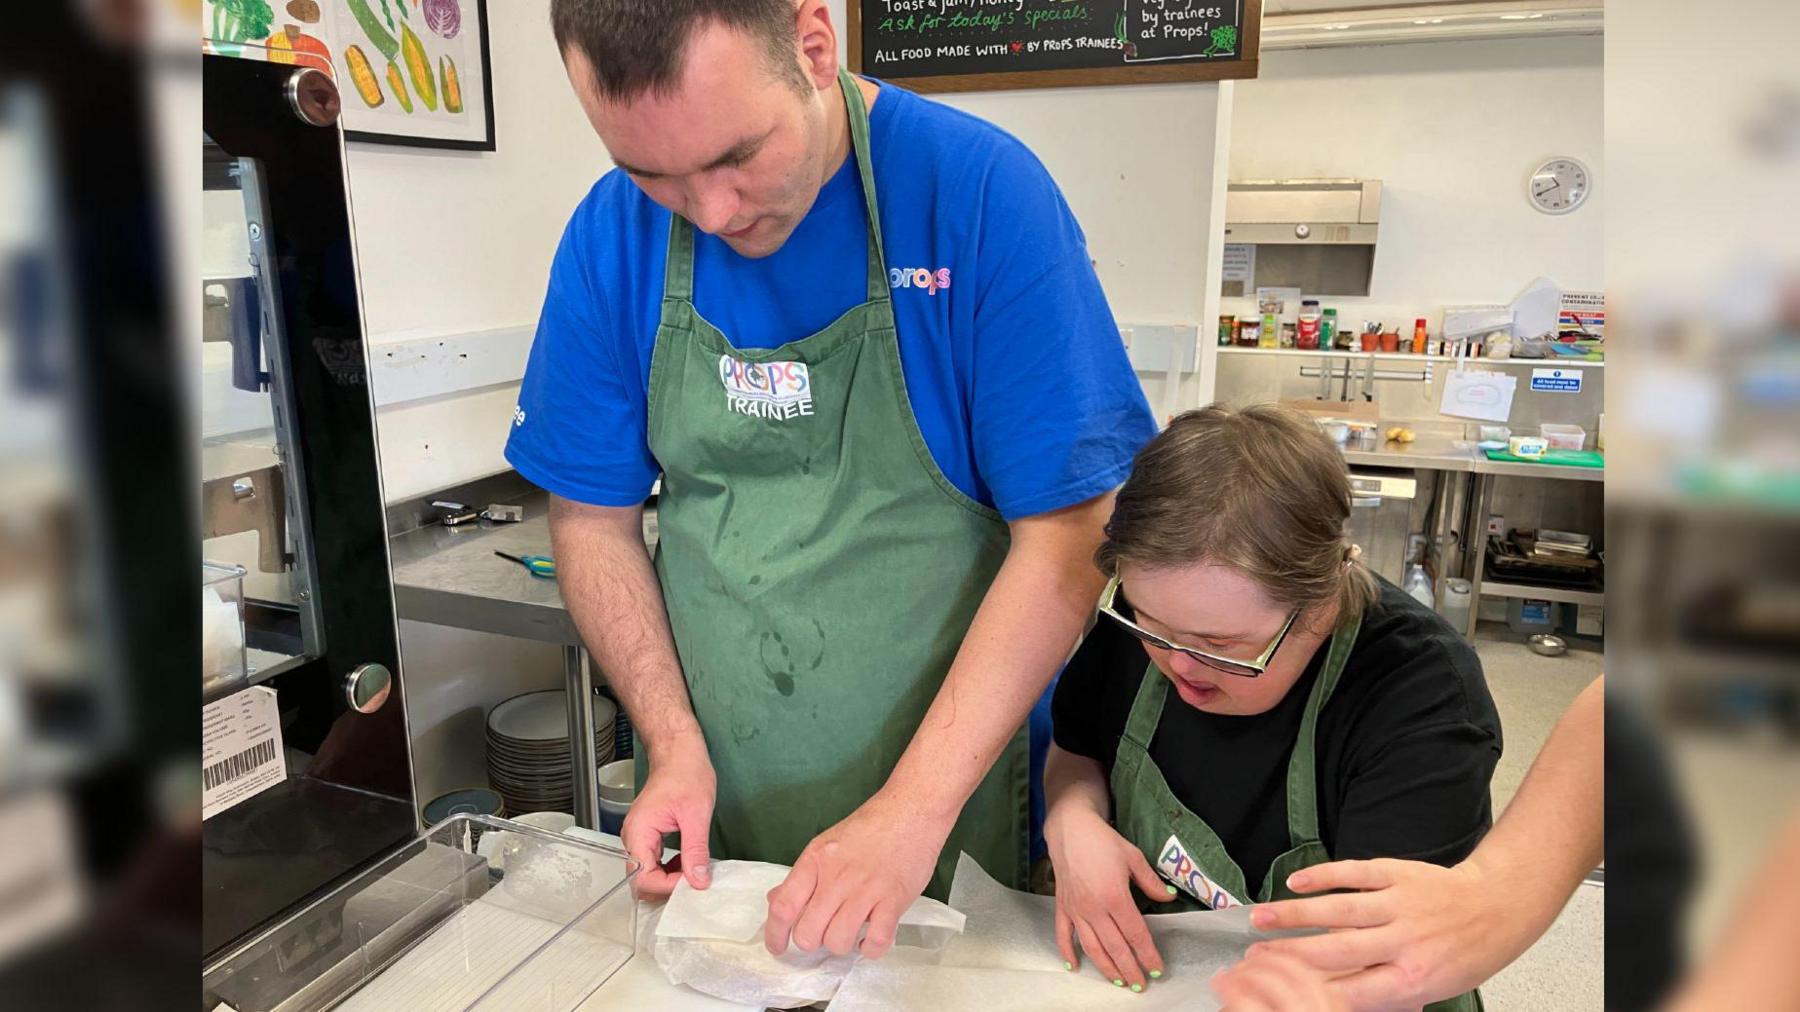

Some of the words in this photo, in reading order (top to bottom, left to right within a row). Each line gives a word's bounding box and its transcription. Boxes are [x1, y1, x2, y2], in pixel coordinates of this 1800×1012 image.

[878, 14, 915, 32] Ask
[919, 14, 946, 33] for
[947, 10, 1015, 32] today's
[1024, 4, 1087, 29] specials
[881, 0, 924, 12] Toast
[1142, 9, 1158, 28] by
[1163, 7, 1221, 21] trainees
[1141, 26, 1156, 38] at
[1163, 22, 1208, 41] Props!
[875, 49, 899, 63] ALL
[901, 47, 931, 60] FOOD
[937, 45, 971, 57] MADE
[976, 44, 1007, 56] WITH
[1027, 41, 1040, 52] BY
[1043, 38, 1073, 51] PROPS
[1075, 36, 1123, 49] TRAINEES
[723, 357, 807, 395] PROPS
[726, 393, 815, 421] TRAINEE
